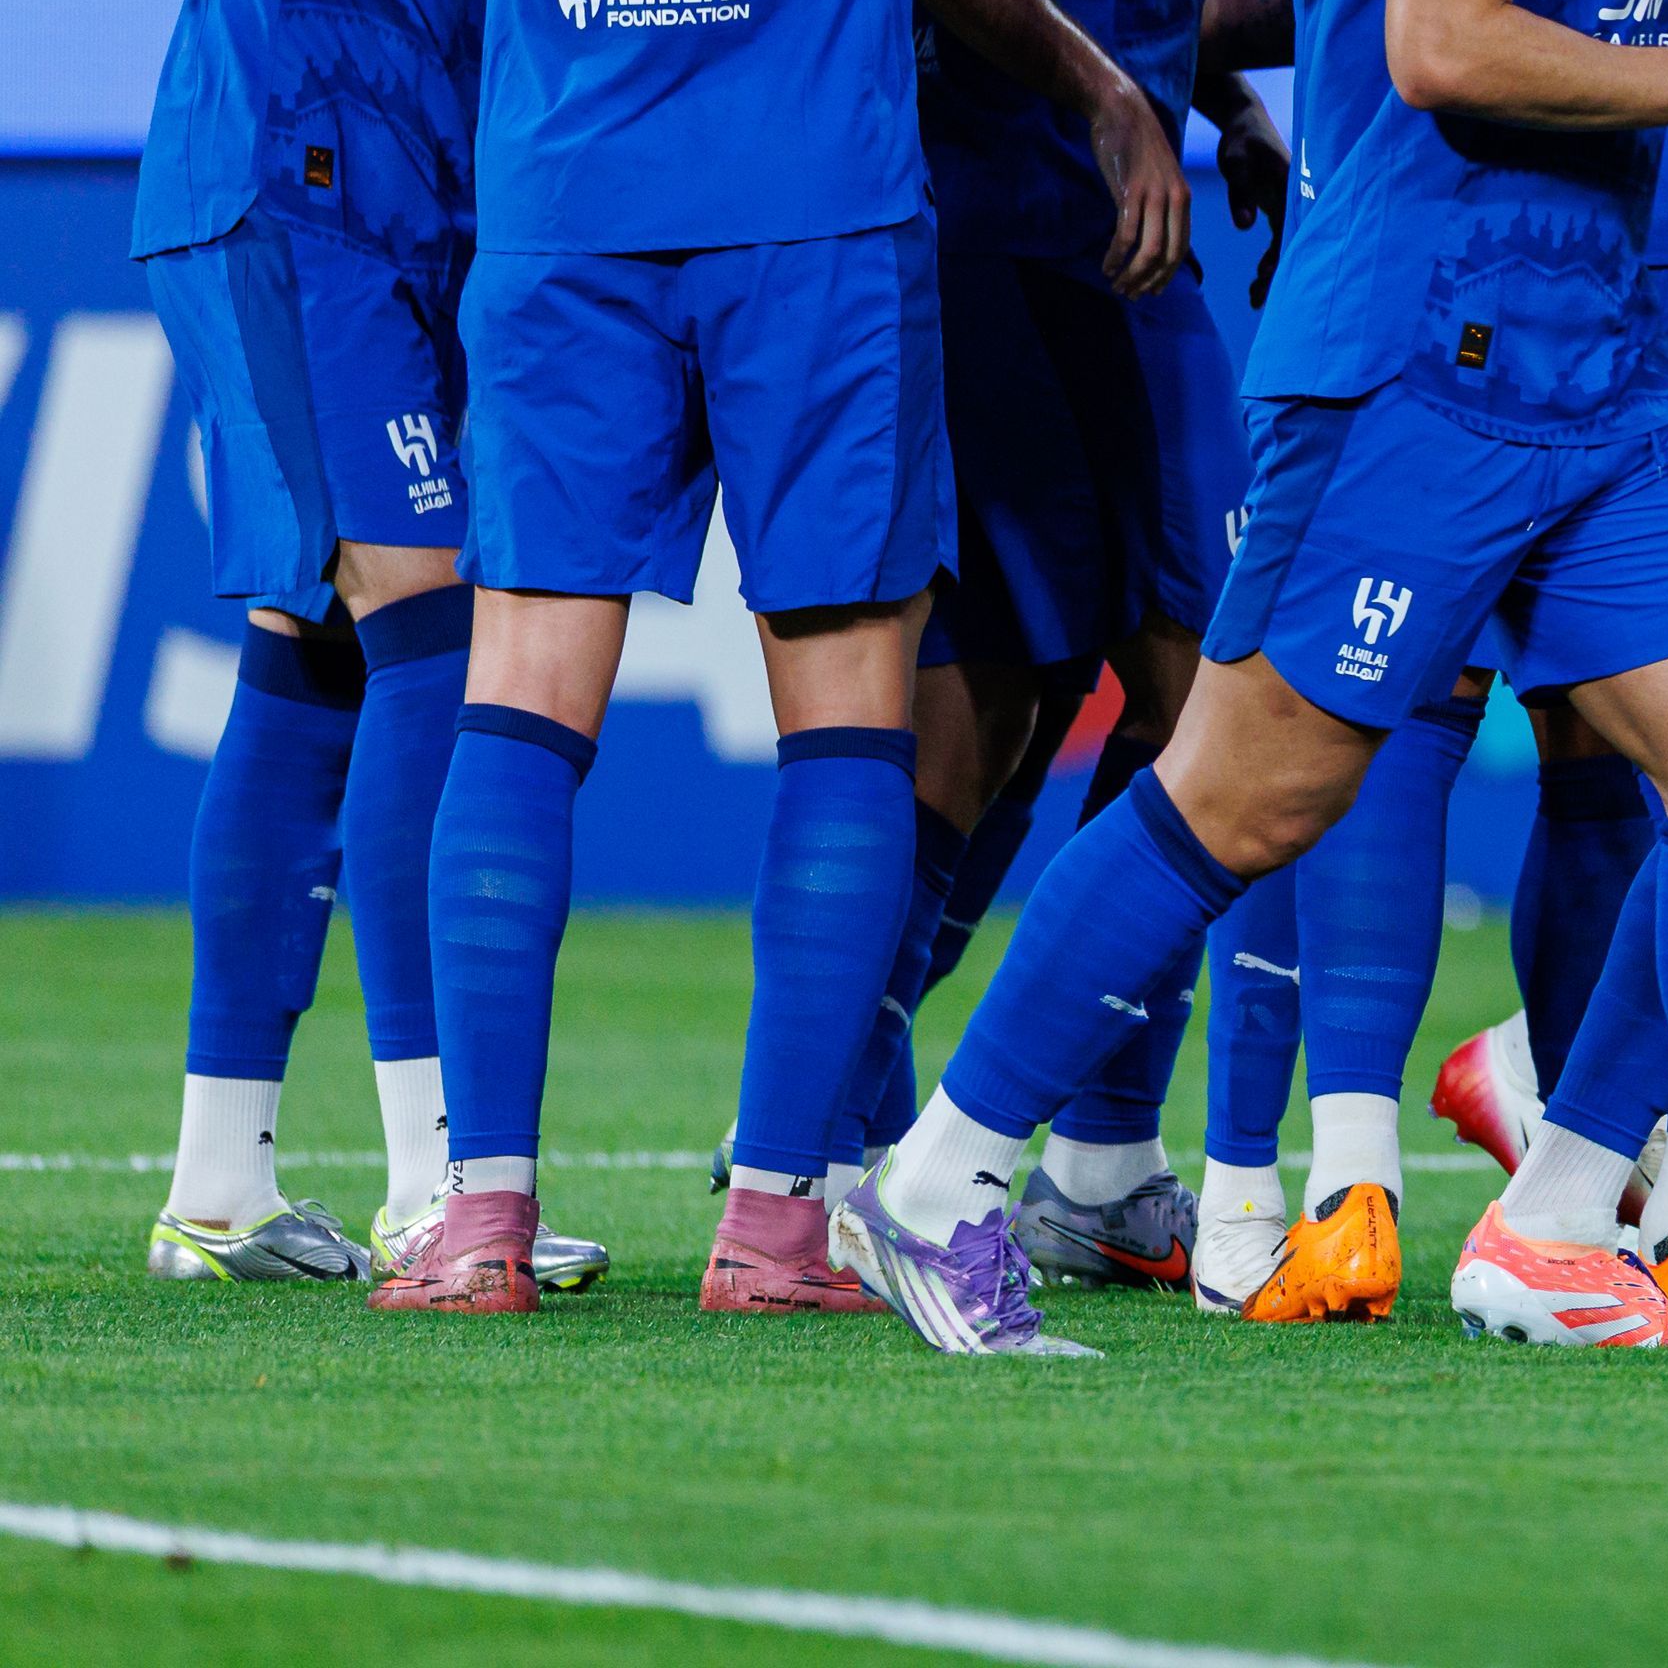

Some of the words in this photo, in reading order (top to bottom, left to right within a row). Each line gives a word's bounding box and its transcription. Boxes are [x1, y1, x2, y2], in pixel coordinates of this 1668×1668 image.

[607, 3, 750, 27] FOUNDATION
[408, 477, 450, 499] ALHILAL
[1338, 644, 1389, 668] ALHILAL
[1335, 660, 1384, 682] الهلال
